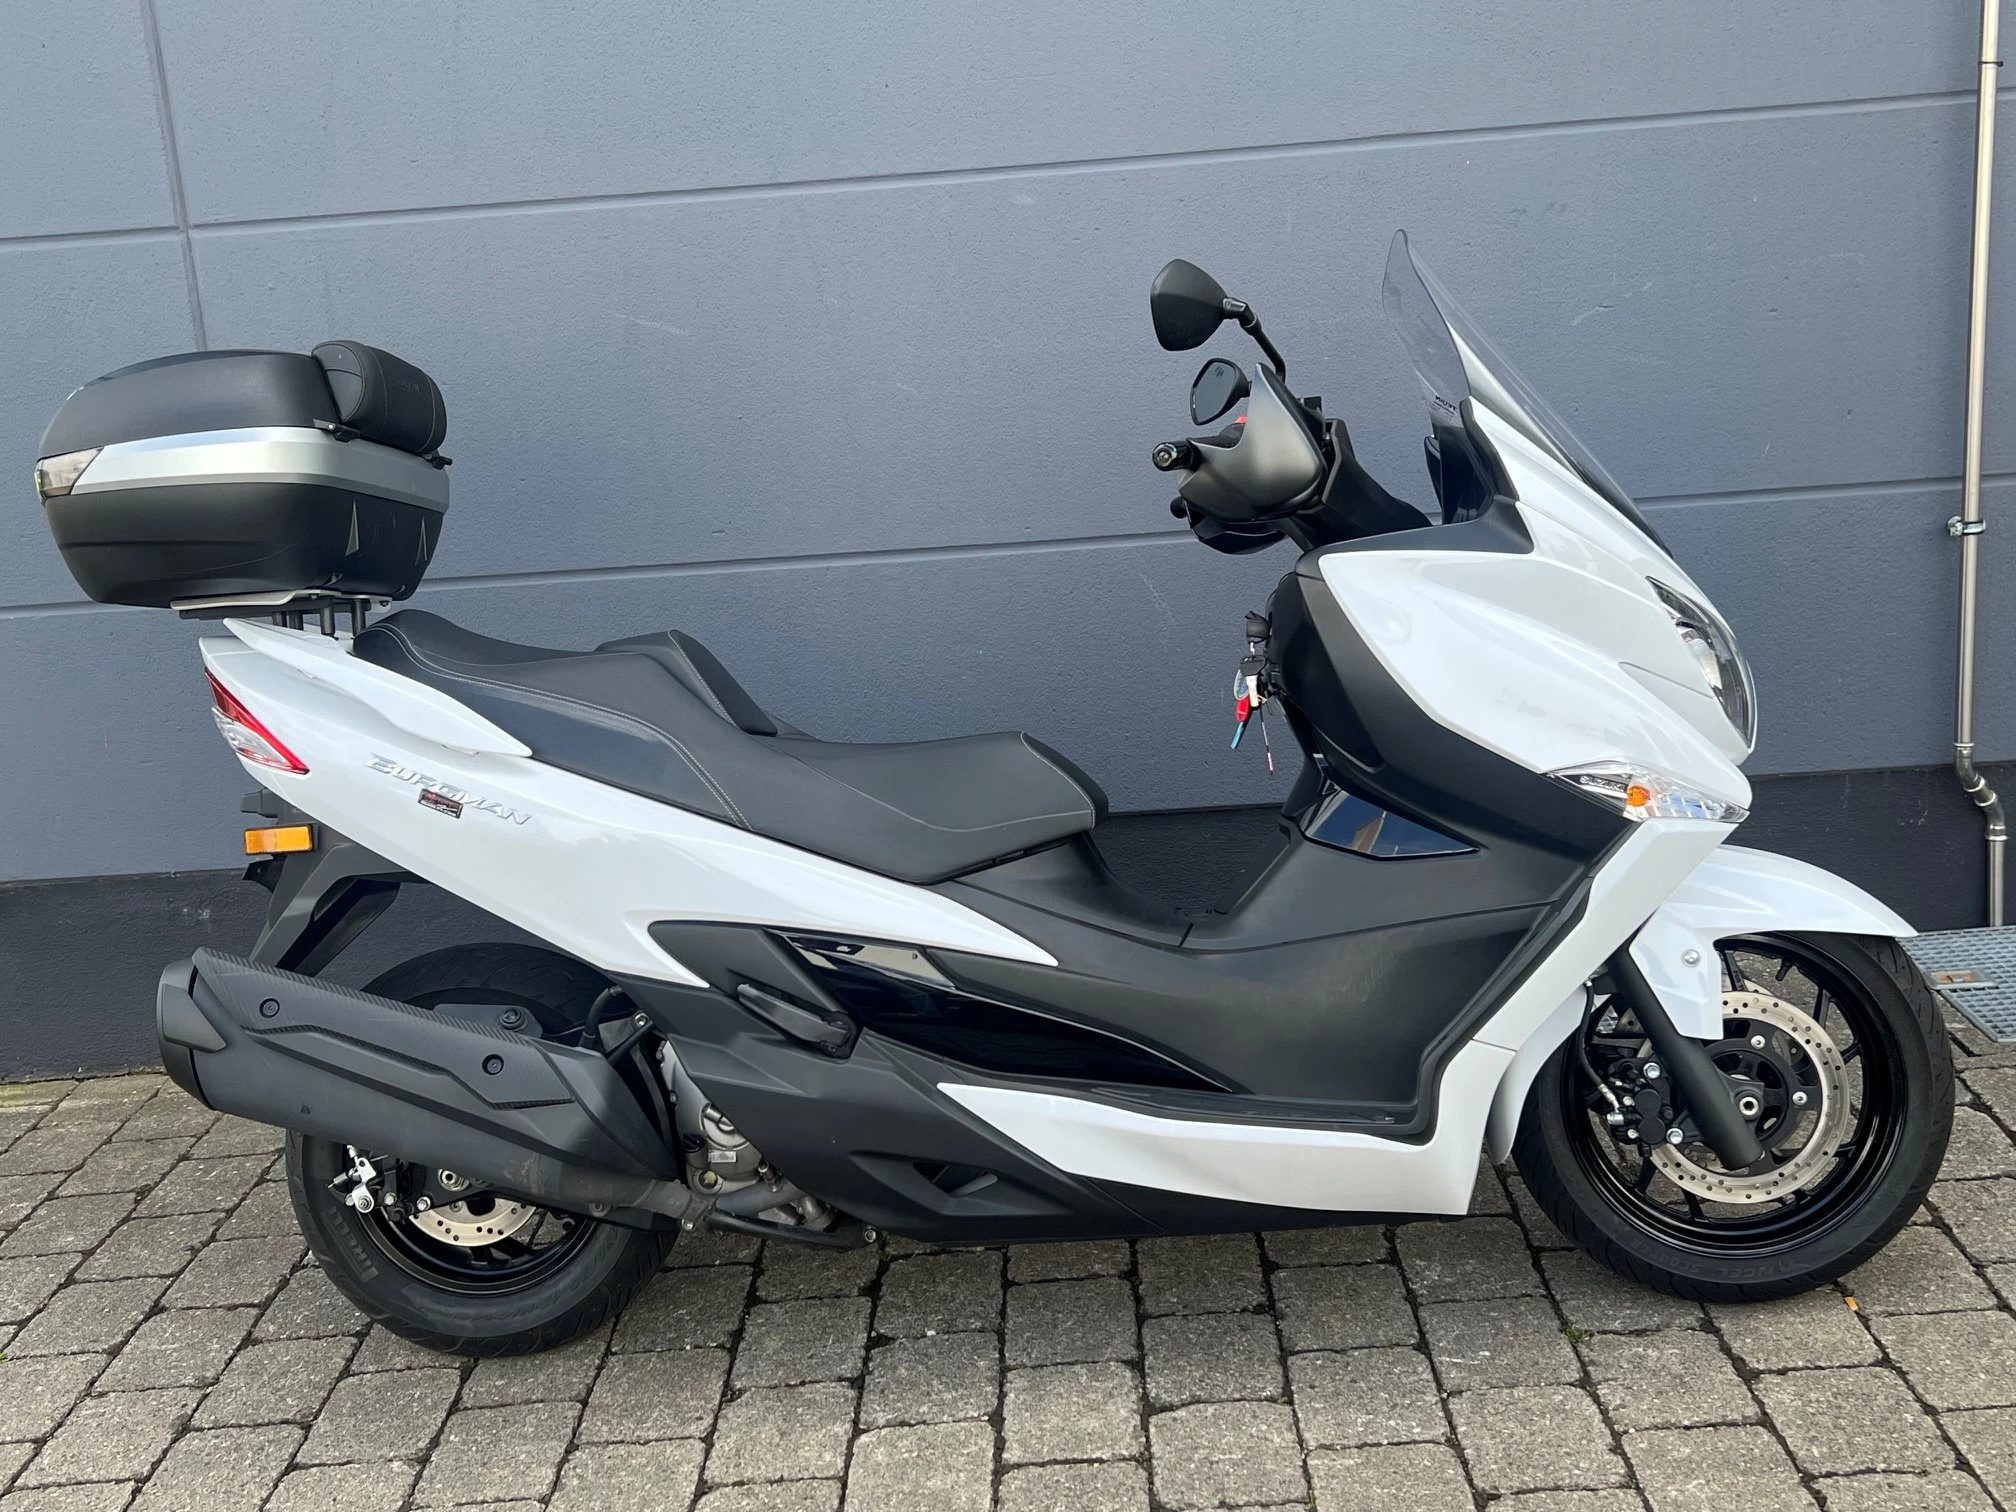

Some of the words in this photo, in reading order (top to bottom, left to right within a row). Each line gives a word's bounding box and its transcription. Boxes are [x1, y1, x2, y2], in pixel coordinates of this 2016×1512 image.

[365, 753, 531, 825] BURGMAN
[321, 1206, 379, 1283] PIRELLI
[1631, 1240, 1701, 1274] SCOOTER
[1715, 1260, 1812, 1278] ANGEL
